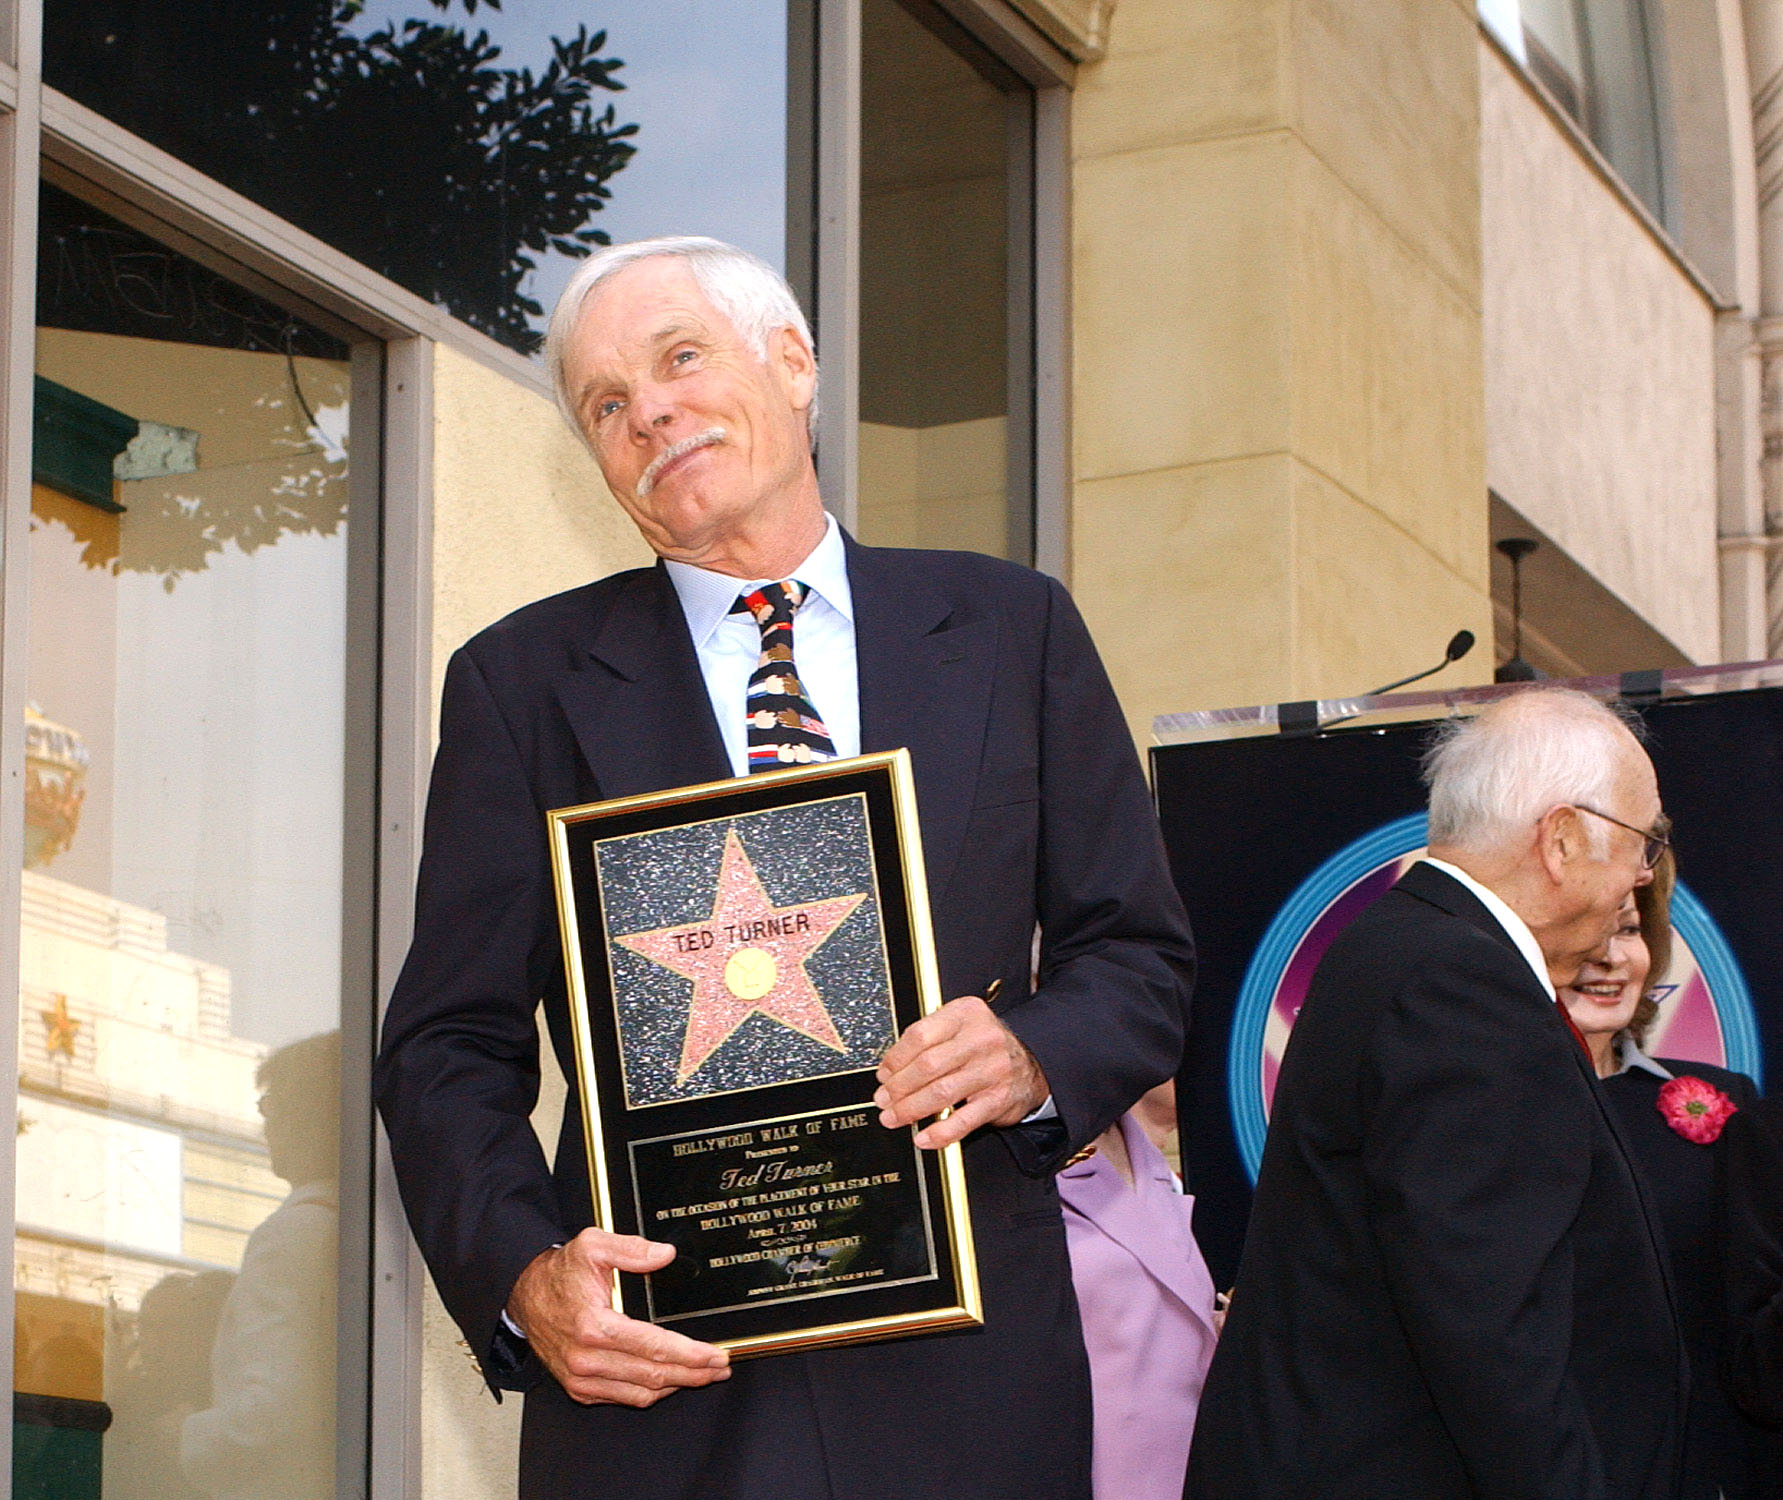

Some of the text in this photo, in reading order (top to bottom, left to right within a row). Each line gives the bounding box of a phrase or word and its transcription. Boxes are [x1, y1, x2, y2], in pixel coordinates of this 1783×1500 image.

[672, 913, 810, 953] TED TURNER
[673, 1113, 867, 1155] HOLLYWOOD WALK OF FAME
[719, 1161, 832, 1189] Ted Turner
[700, 1195, 860, 1230] HOLLYWOOD WALK OF FAME
[790, 1218, 817, 1231] 2004
[709, 1251, 760, 1267] HOLLYWOOD
[802, 1242, 813, 1253] OF
